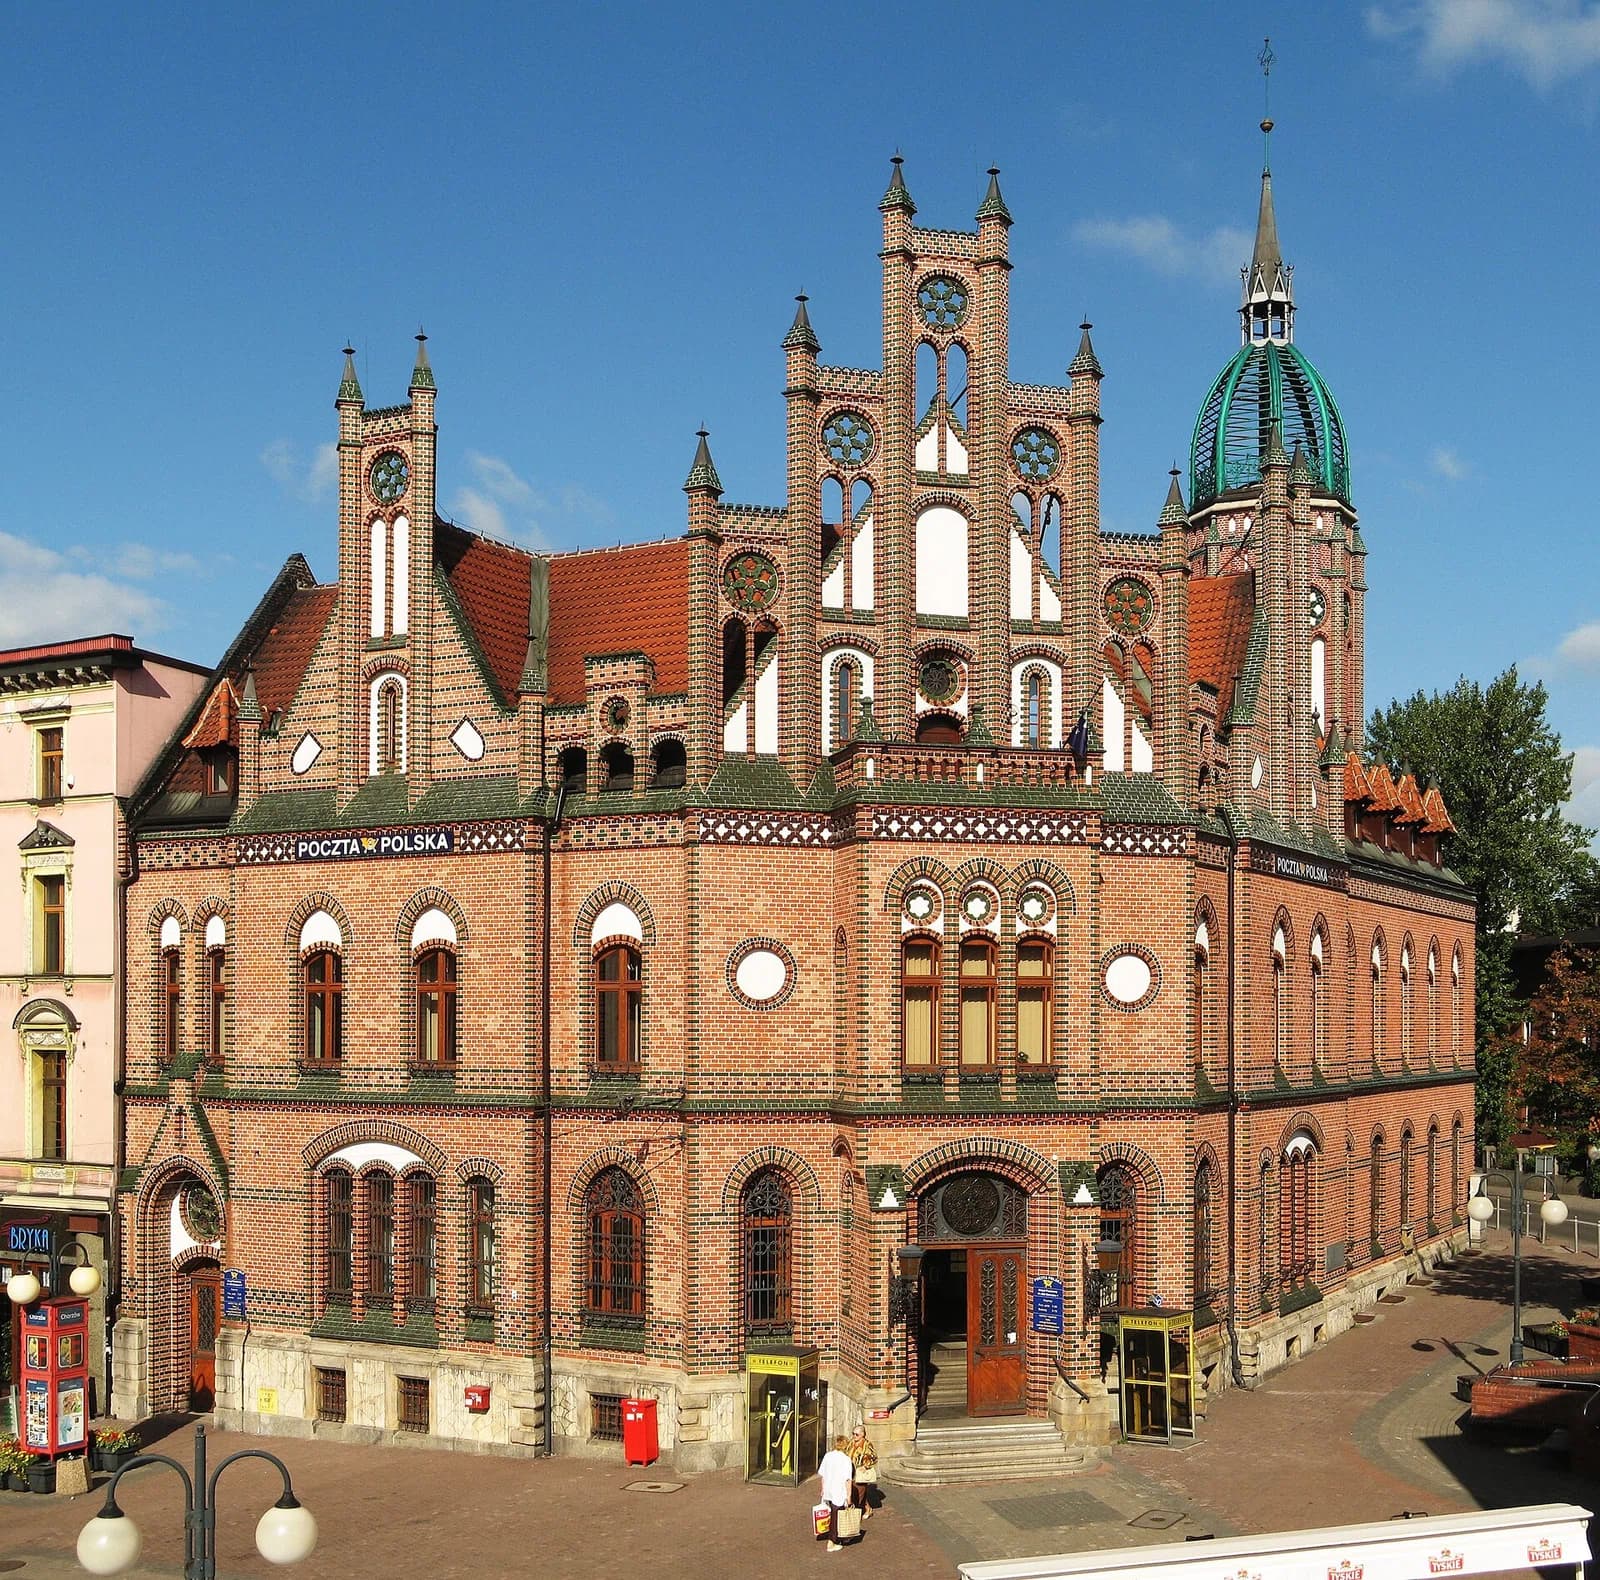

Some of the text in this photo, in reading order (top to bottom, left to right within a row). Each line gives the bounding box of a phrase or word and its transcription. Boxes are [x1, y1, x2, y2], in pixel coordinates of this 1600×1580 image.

[298, 833, 448, 857] POCZTA POLSKA
[1277, 857, 1328, 882] POCZTA POLSKA
[10, 1226, 49, 1250] BRYKA
[758, 1358, 789, 1366] TELEFON
[1530, 1548, 1560, 1561] TYSKIE
[1431, 1559, 1462, 1572] TYSKIE
[1330, 1569, 1361, 1580] TYSKIE
